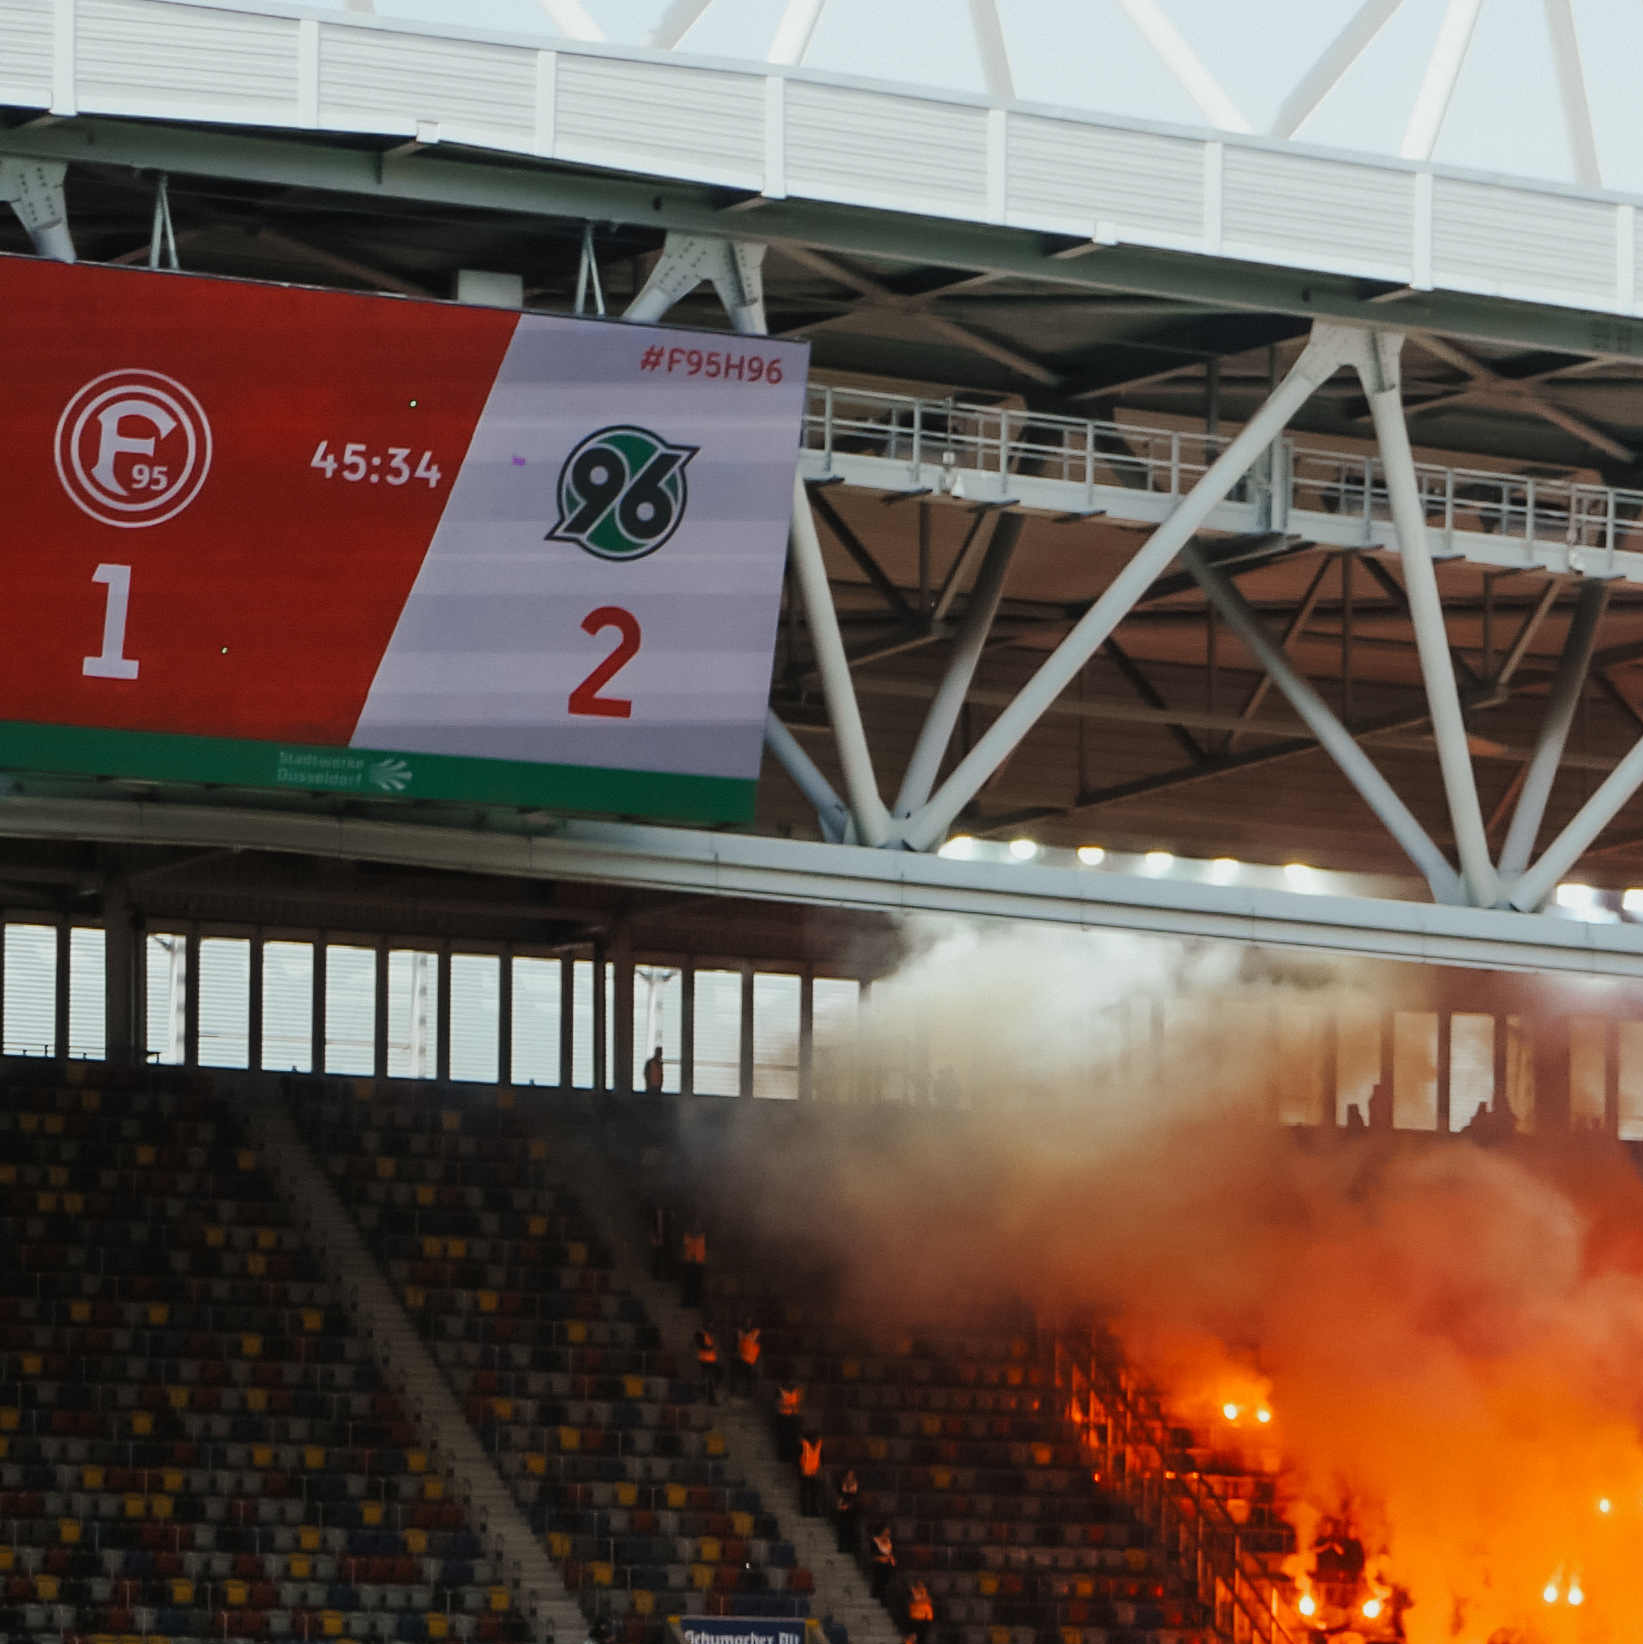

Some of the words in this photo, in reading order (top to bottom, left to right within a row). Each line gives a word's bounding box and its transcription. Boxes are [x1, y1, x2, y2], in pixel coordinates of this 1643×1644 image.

[640, 344, 784, 384] #F95H96
[311, 441, 442, 489] 45:34
[548, 443, 698, 541] 96
[81, 563, 140, 680] 1
[566, 606, 643, 718] 2
[278, 751, 364, 769] Stadtwerke
